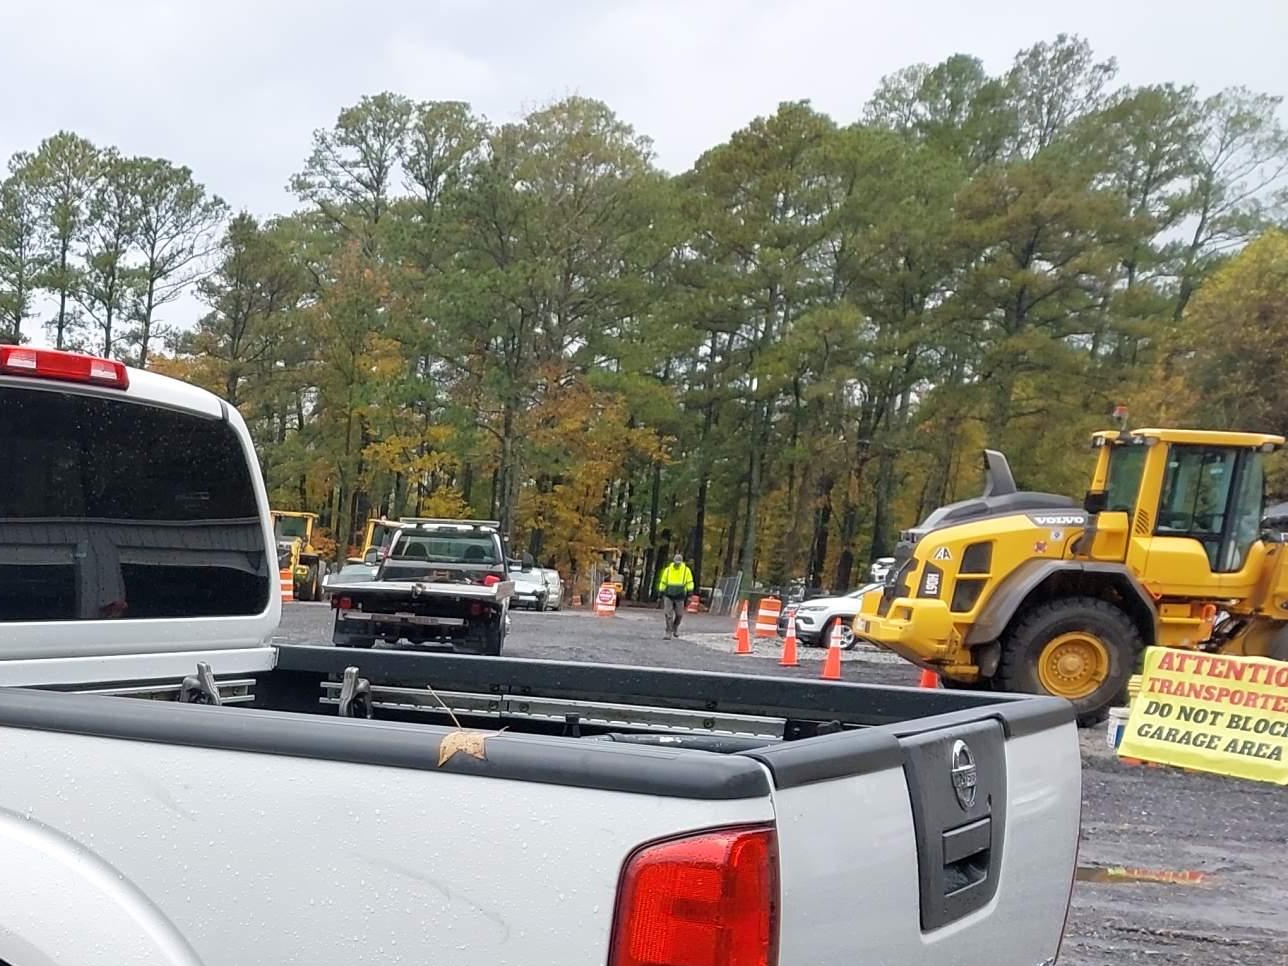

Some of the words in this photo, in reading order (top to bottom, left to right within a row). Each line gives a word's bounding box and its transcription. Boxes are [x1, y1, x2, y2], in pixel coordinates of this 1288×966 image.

[1033, 516, 1085, 525] VOLVO
[924, 573, 940, 595] L90H
[1148, 677, 1288, 713] TRANSPORTE
[1144, 701, 1173, 718] DO
[1176, 706, 1224, 726] NOT
[1137, 723, 1222, 750] GARAGE
[1223, 738, 1283, 761] AREA
